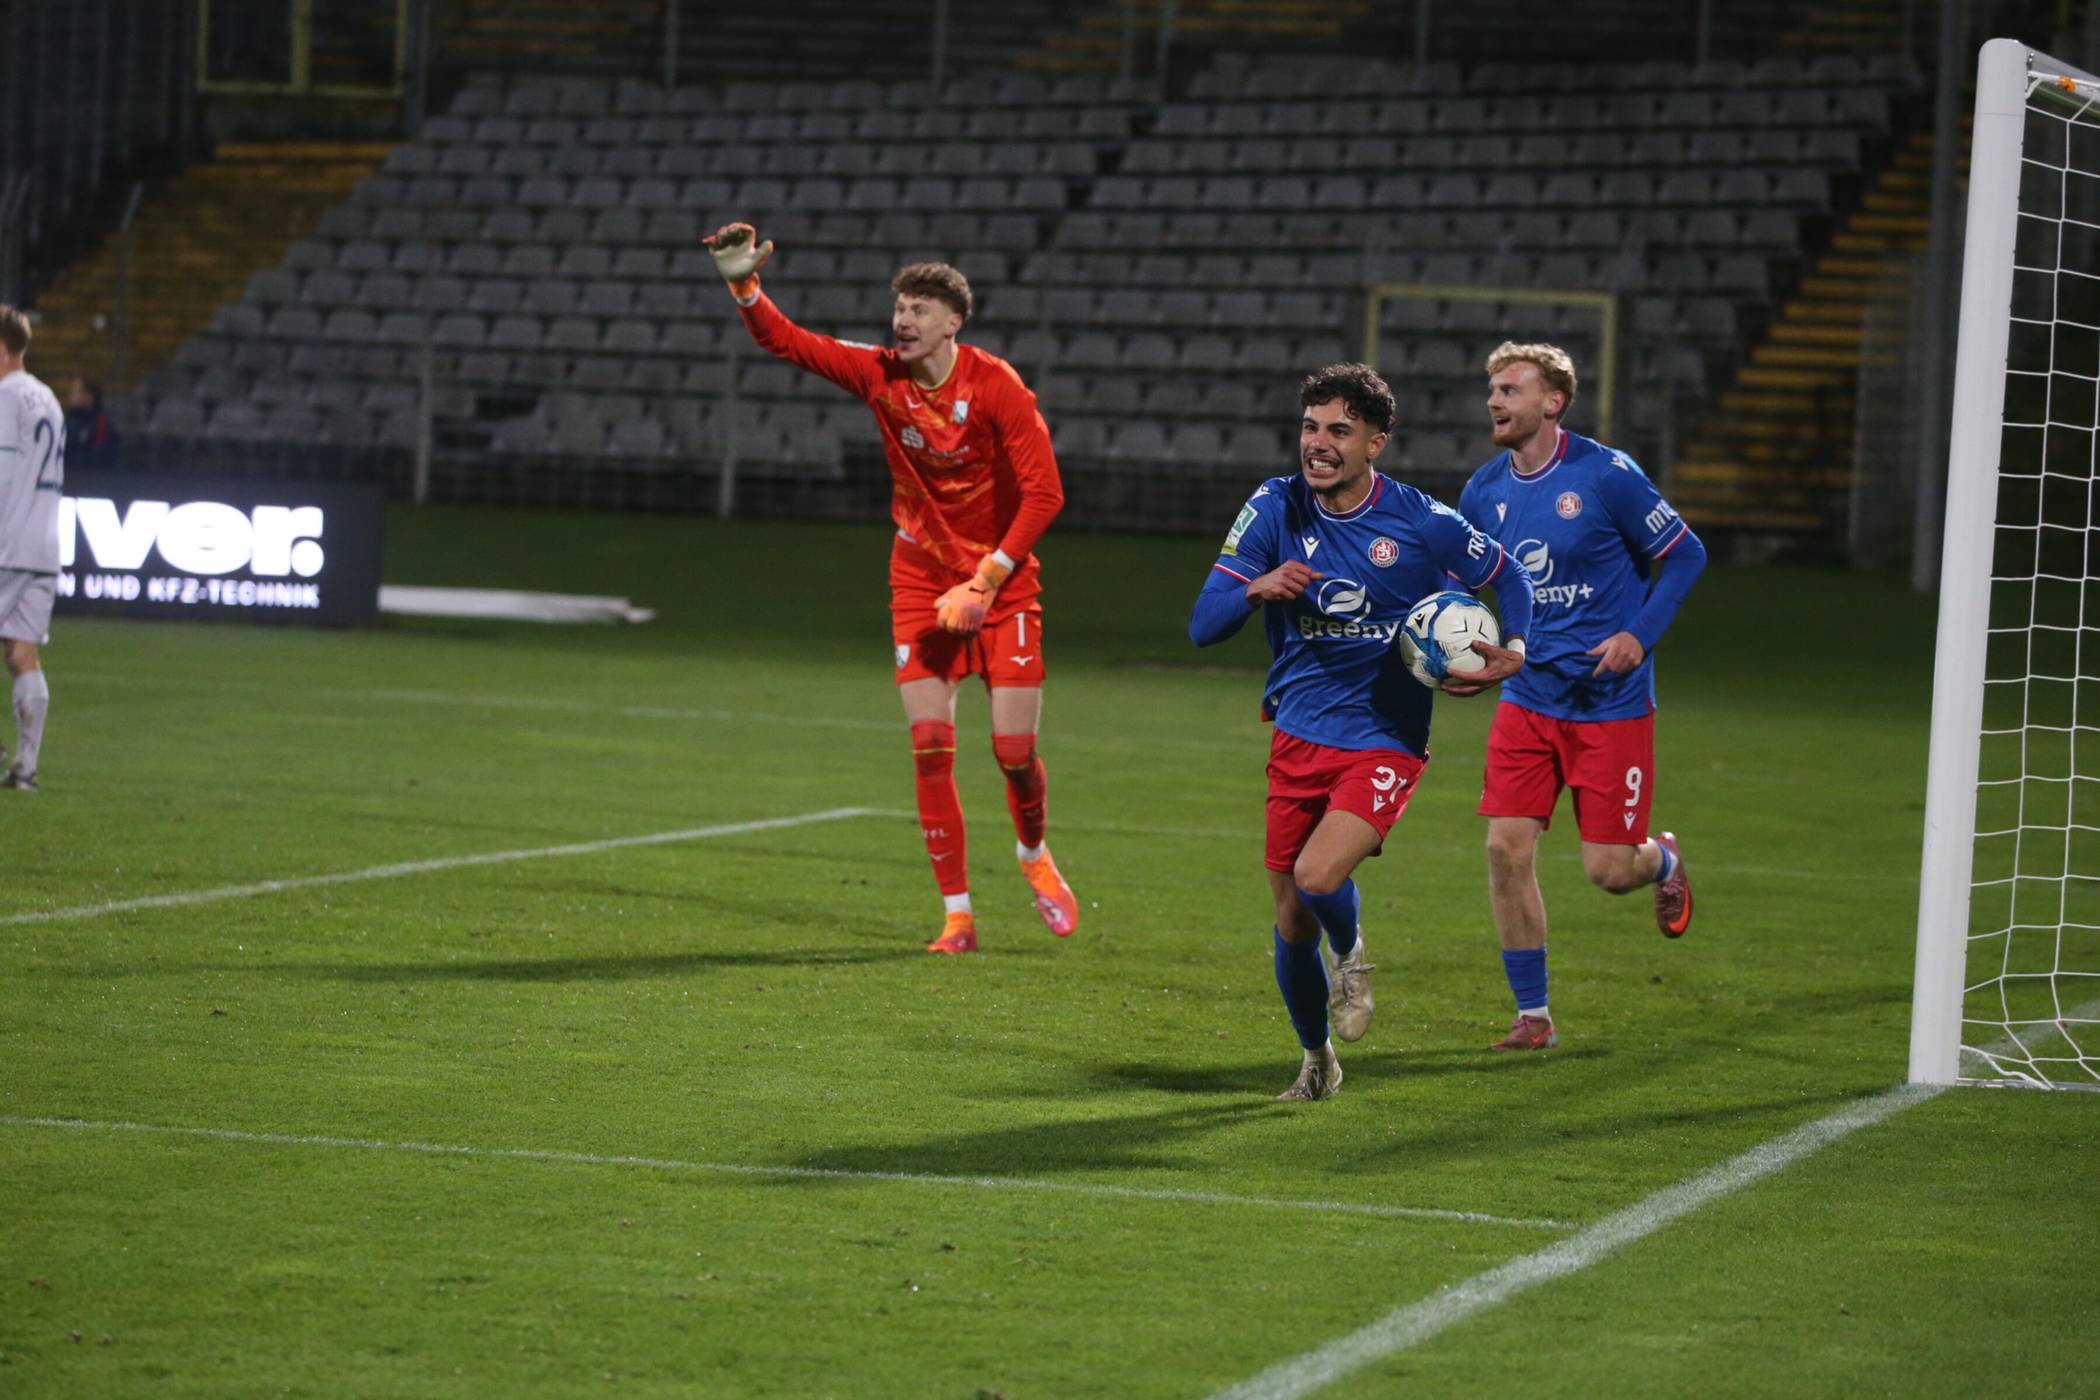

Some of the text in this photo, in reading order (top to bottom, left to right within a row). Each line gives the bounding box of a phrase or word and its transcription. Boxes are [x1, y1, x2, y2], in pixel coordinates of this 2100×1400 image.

[84, 573, 141, 600] UND
[147, 576, 320, 608] KFZ-TECHNIK
[1015, 611, 1026, 647] 1
[1625, 766, 1643, 807] 9
